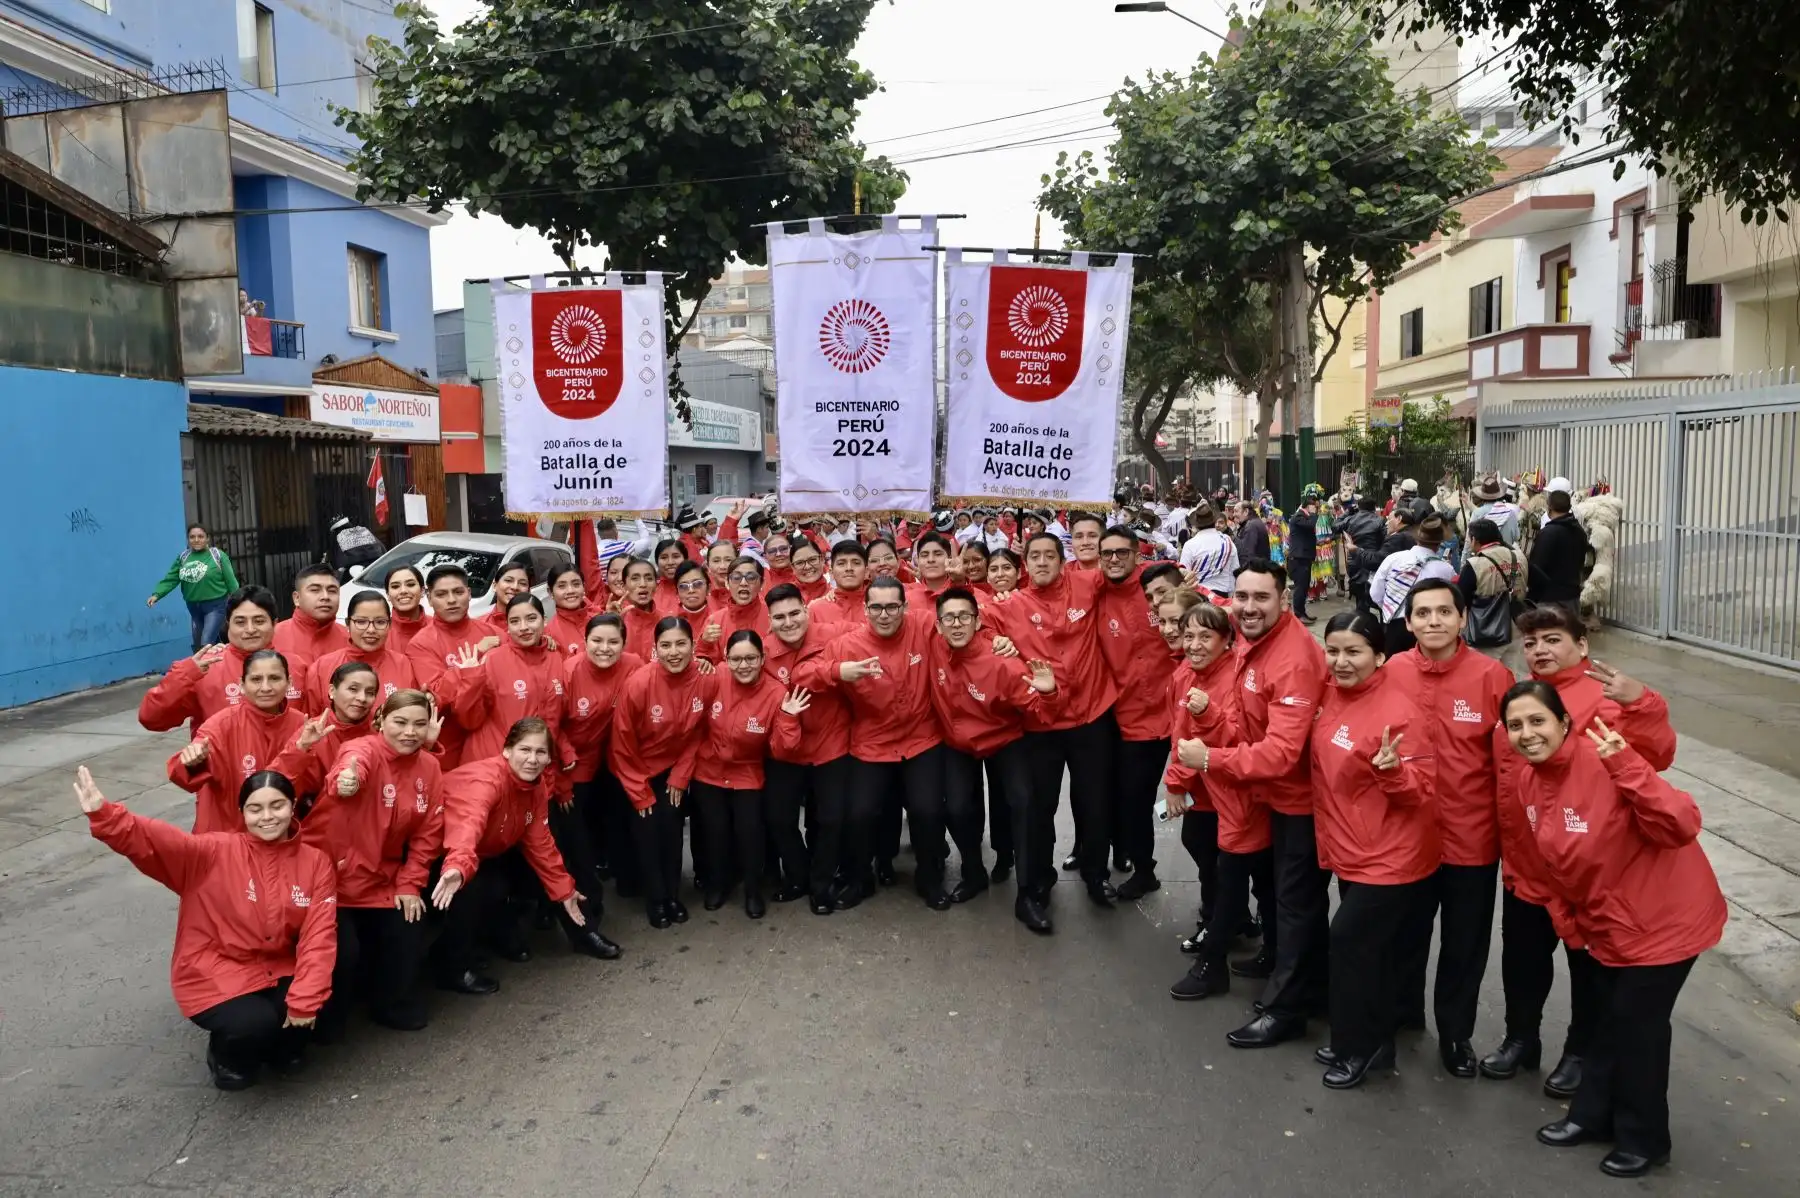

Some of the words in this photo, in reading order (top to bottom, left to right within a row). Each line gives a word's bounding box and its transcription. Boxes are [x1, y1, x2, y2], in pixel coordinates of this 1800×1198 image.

[1000, 350, 1066, 361] BICENTENARIO
[1020, 359, 1049, 372] PERÚ
[546, 368, 608, 377] BICENTENARIO
[1015, 372, 1051, 385] 2024
[564, 375, 592, 387] PERÚ
[562, 389, 596, 400] 2024
[322, 392, 364, 412] SABOR
[377, 398, 427, 417] NORTEÑO
[815, 400, 900, 412] BICENTENARIO
[838, 413, 884, 433] PERÚ
[989, 423, 1009, 433] 200
[1011, 423, 1039, 436] años
[1042, 427, 1057, 437] de
[1059, 428, 1069, 438] la
[543, 440, 560, 450] 200
[563, 438, 591, 448] años
[594, 438, 608, 448] de
[612, 438, 623, 448] la
[832, 438, 891, 457] 2024
[983, 438, 1045, 458] Batalla
[1050, 443, 1073, 460] de
[541, 453, 599, 471] Batalla
[604, 453, 627, 469] de
[983, 457, 1071, 481] Ayacucho
[553, 470, 613, 490] Junín
[982, 483, 988, 493] 9
[990, 485, 999, 494] de
[1001, 486, 1036, 497] diciembre
[1038, 488, 1049, 498] de
[1052, 489, 1069, 499] 1824
[562, 498, 589, 508] agosto
[592, 497, 603, 506] de
[607, 496, 625, 506] 1824
[1453, 711, 1482, 719] TARIOS
[1563, 807, 1574, 815] VO
[1564, 814, 1580, 822] LUN
